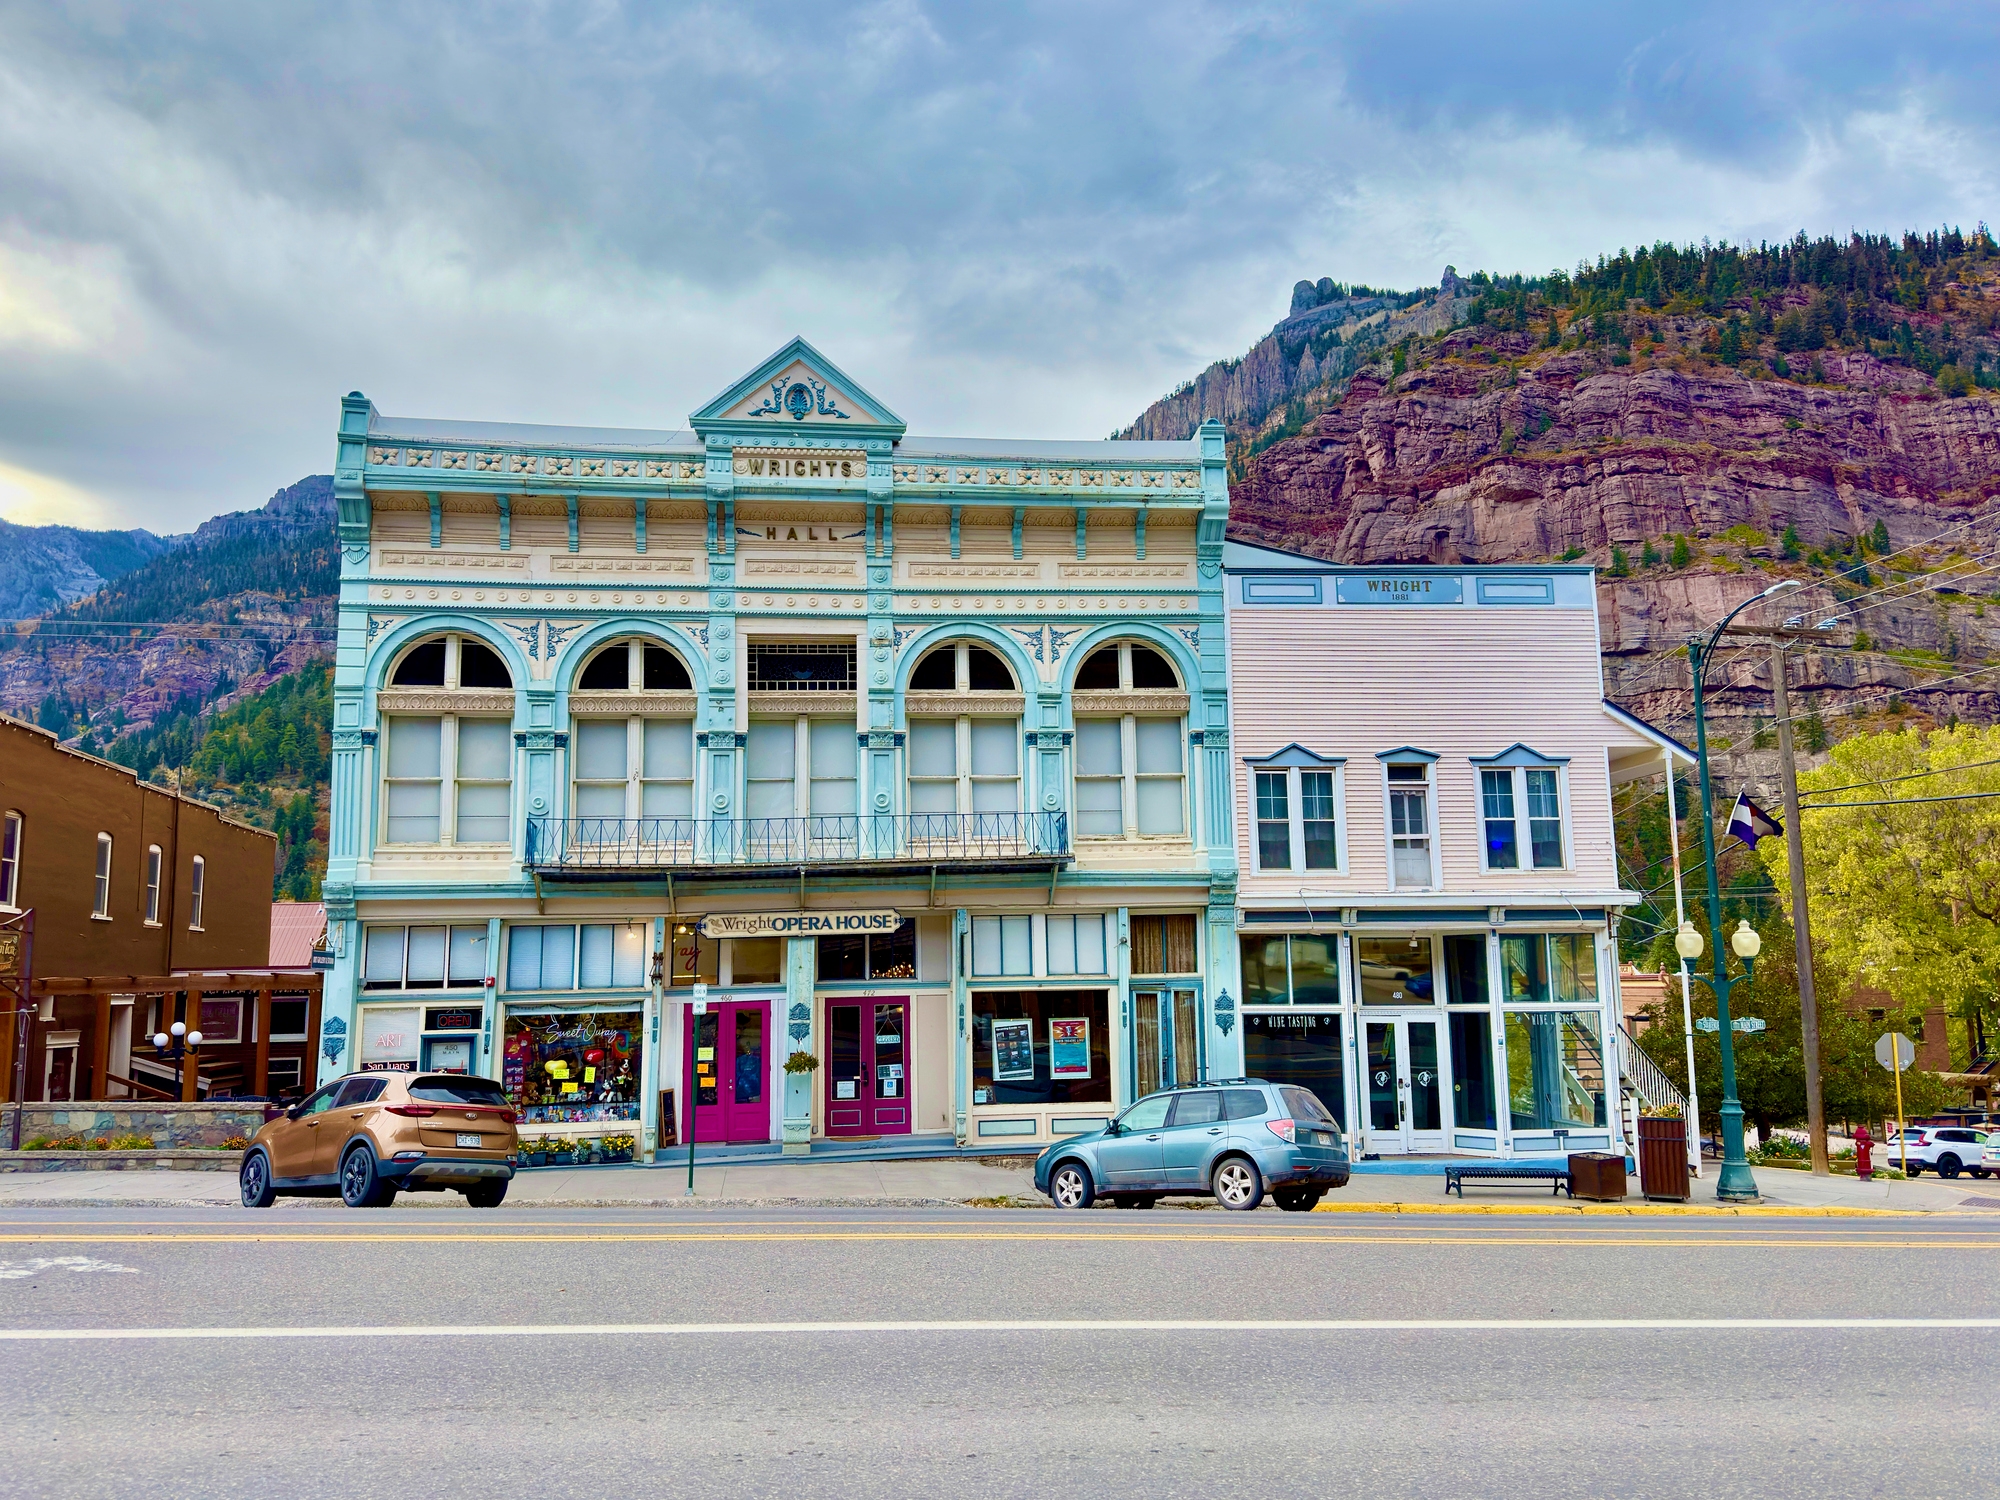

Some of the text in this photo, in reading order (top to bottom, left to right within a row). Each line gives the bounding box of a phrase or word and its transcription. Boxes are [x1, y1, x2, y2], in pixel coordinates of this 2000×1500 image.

[748, 459, 852, 477] WRIGHTS
[766, 527, 838, 541] HALL
[1367, 580, 1433, 592] WRIGHT
[1391, 593, 1409, 601] 1881
[719, 914, 892, 934] Wright OPERA HOUSE
[720, 994, 733, 1002] 460
[1392, 991, 1403, 999] 480
[439, 1015, 471, 1027] OPEN
[1267, 1016, 1317, 1028] WINE TASTING
[1531, 1013, 1548, 1025] WINE
[546, 1021, 619, 1044] Sweet Ouray
[375, 1033, 405, 1048] ART
[367, 1061, 410, 1071] San Juans
